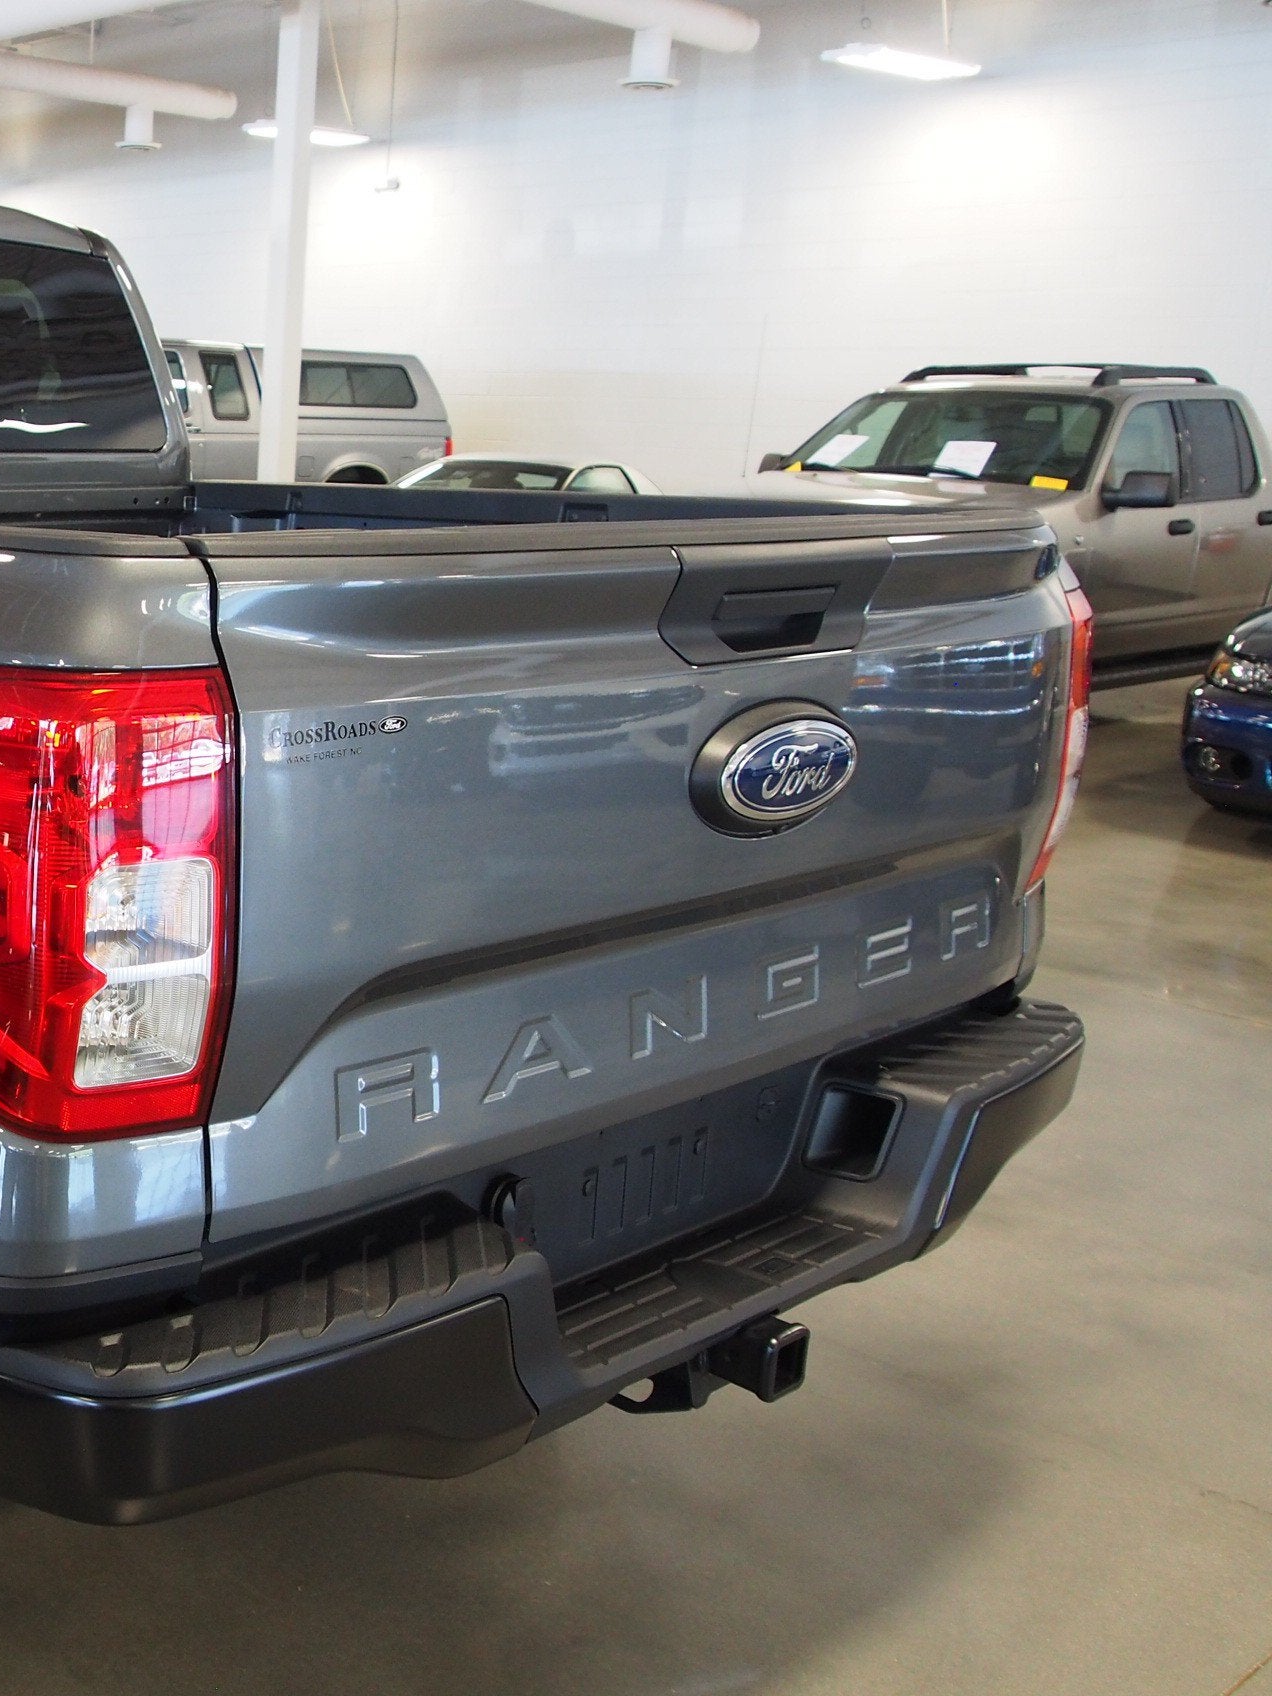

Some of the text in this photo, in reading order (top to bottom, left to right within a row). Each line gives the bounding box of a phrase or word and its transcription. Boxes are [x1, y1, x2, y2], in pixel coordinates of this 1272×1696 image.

[286, 746, 363, 765] WAKE FOREST NC
[762, 742, 835, 800] Ford
[333, 893, 992, 1144] RANGER
